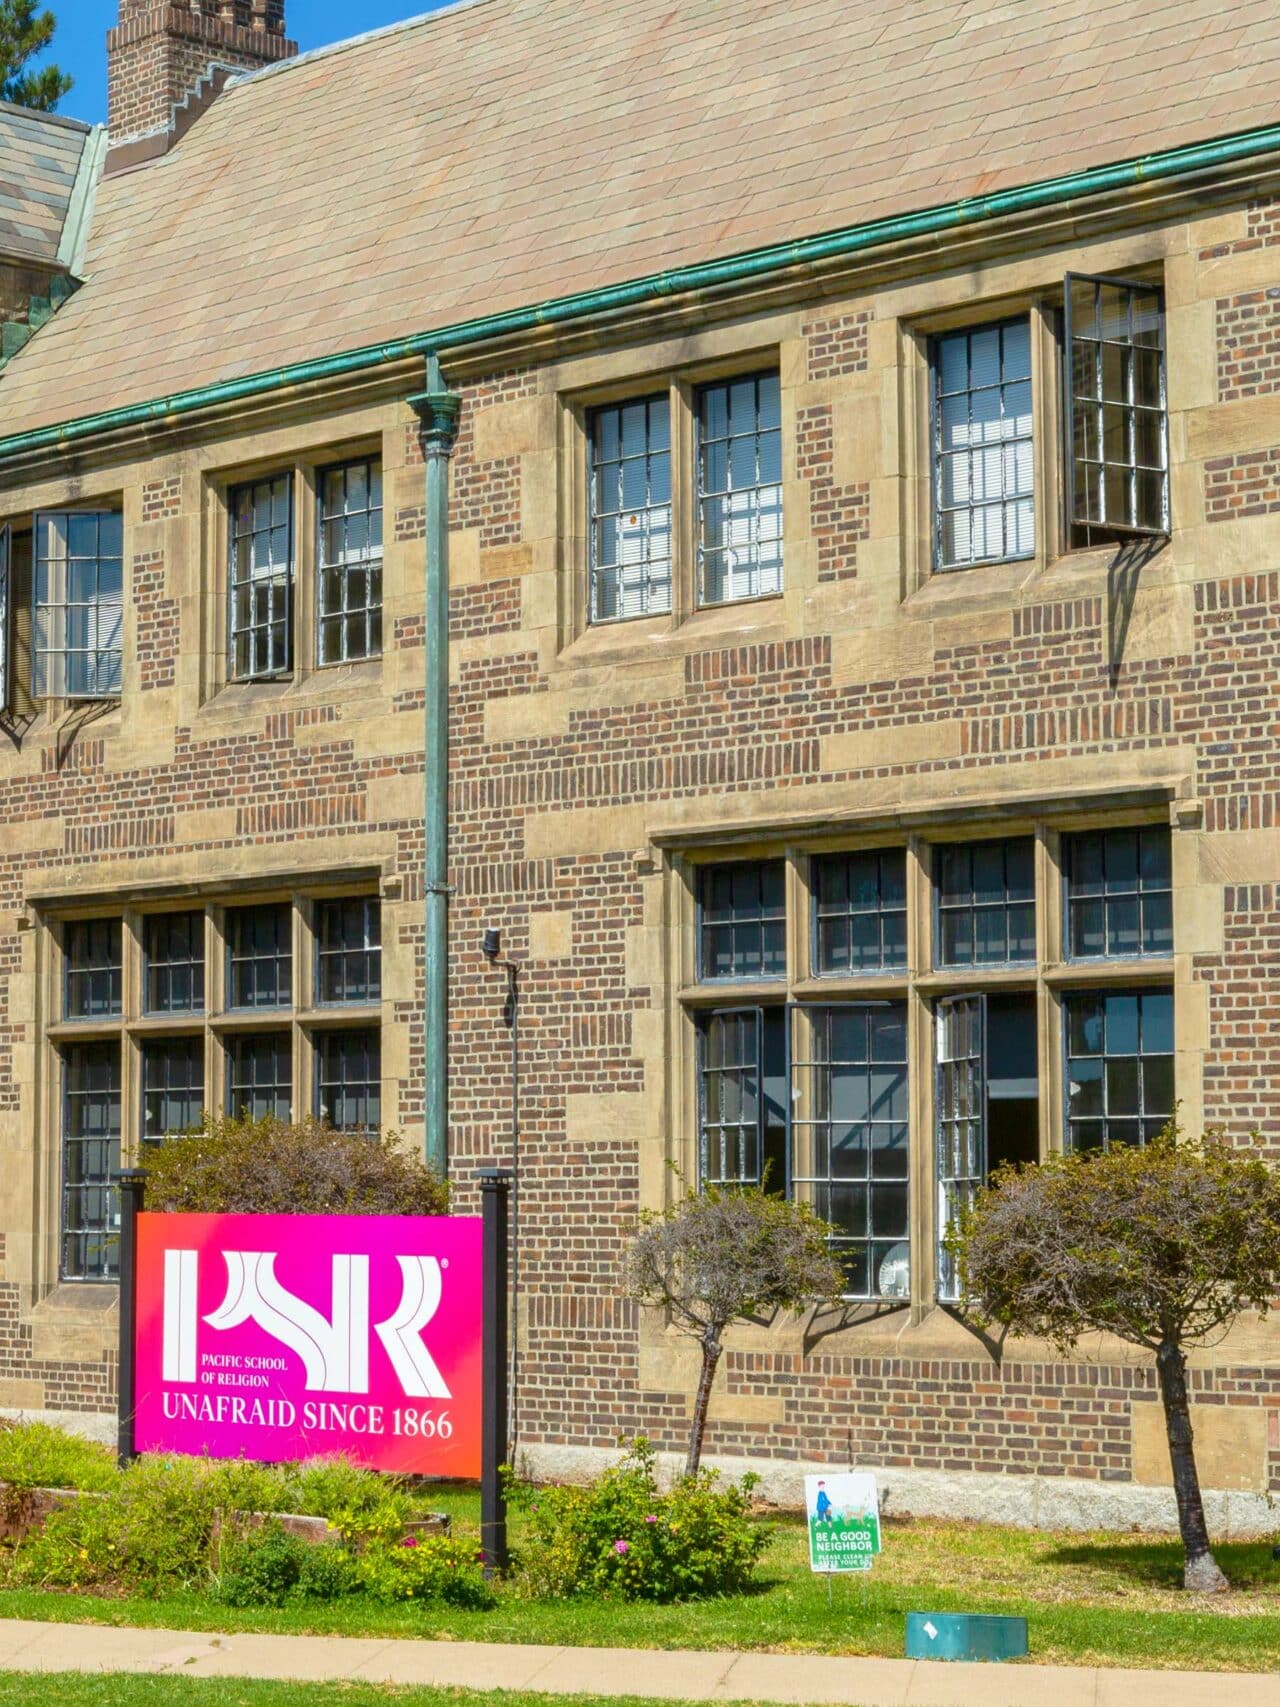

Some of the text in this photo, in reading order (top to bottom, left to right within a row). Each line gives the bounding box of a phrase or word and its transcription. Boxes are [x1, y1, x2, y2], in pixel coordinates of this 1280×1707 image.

[201, 1353, 288, 1371] PACIFIC SCHOOL
[201, 1371, 270, 1388] OF RELIGION
[162, 1391, 453, 1439] UNAFRAID SINCE 1866
[816, 1531, 871, 1541] BE A GOOD
[816, 1541, 872, 1551] NEIGHBOR
